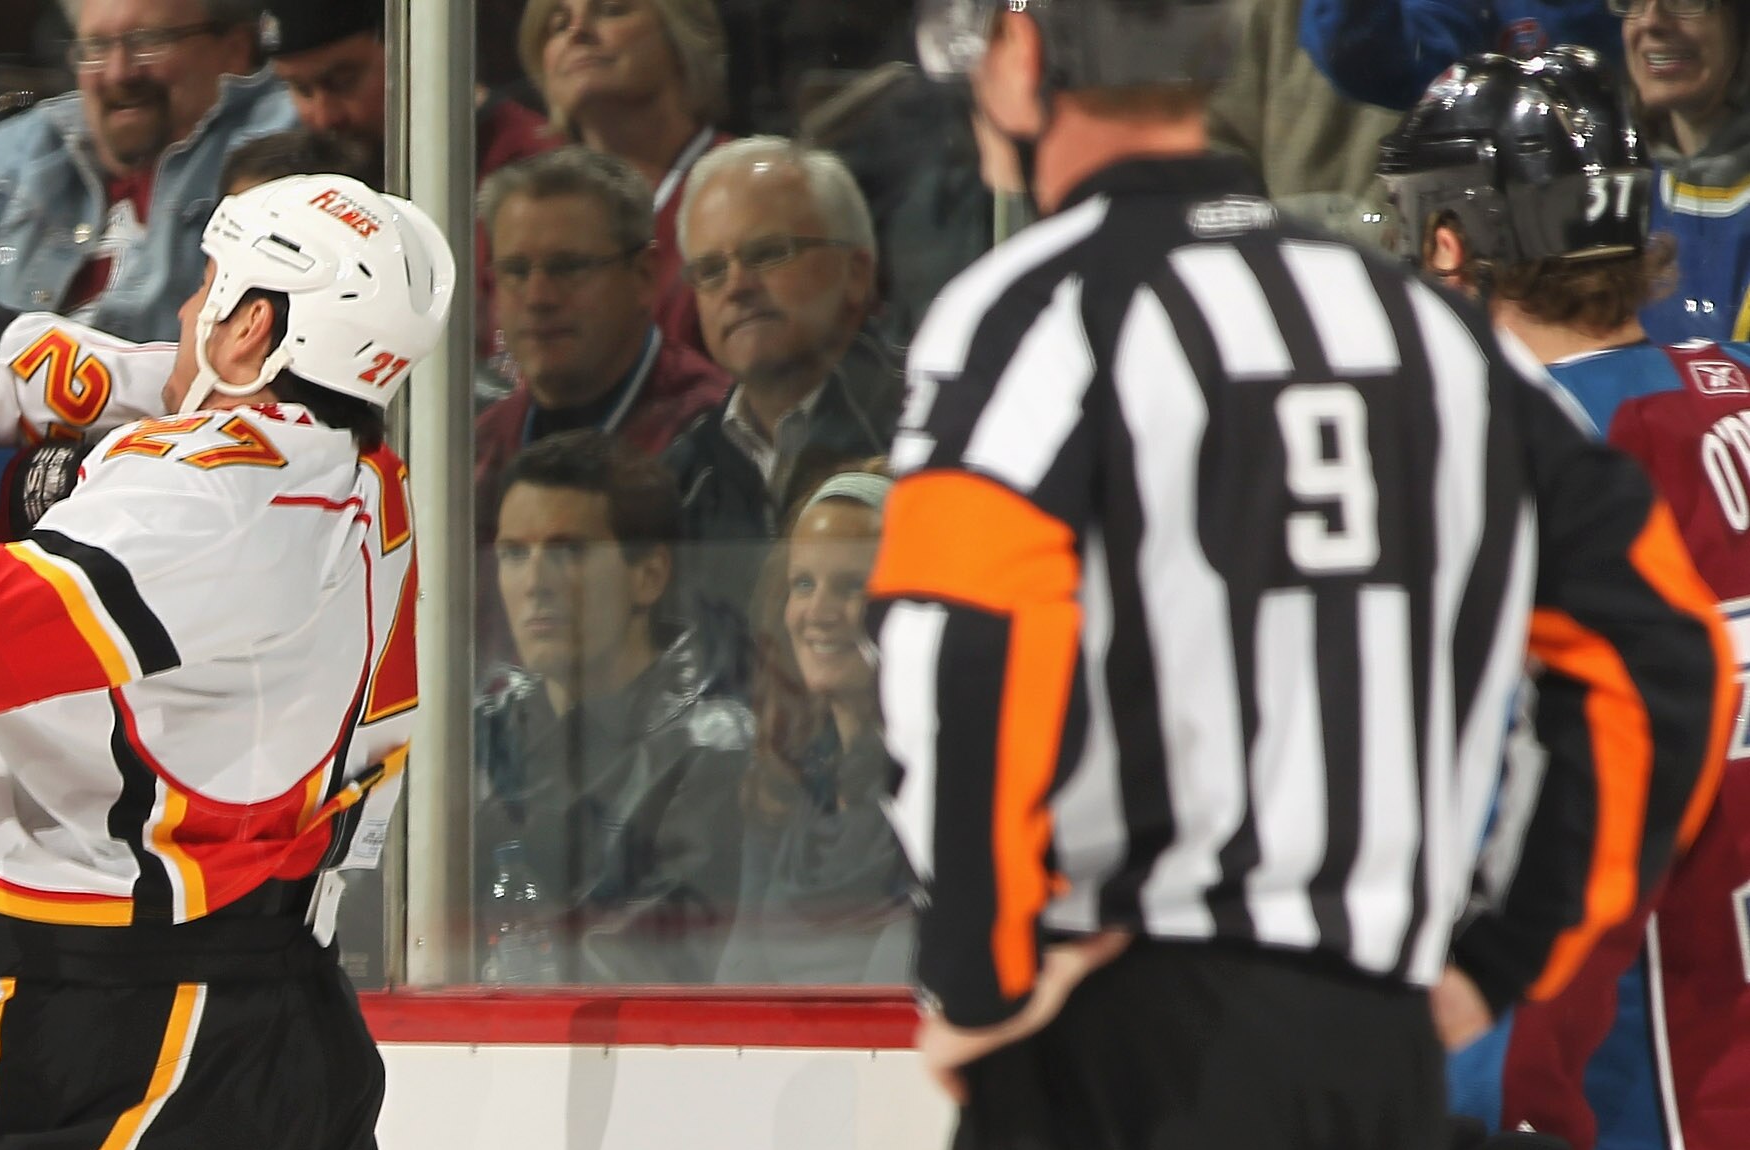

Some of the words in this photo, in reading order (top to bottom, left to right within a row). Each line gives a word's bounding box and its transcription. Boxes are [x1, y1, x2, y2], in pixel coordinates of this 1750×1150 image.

[308, 187, 380, 239] FLAMES
[357, 351, 410, 388] 27
[102, 415, 289, 472] 27
[1274, 382, 1382, 568] 9
